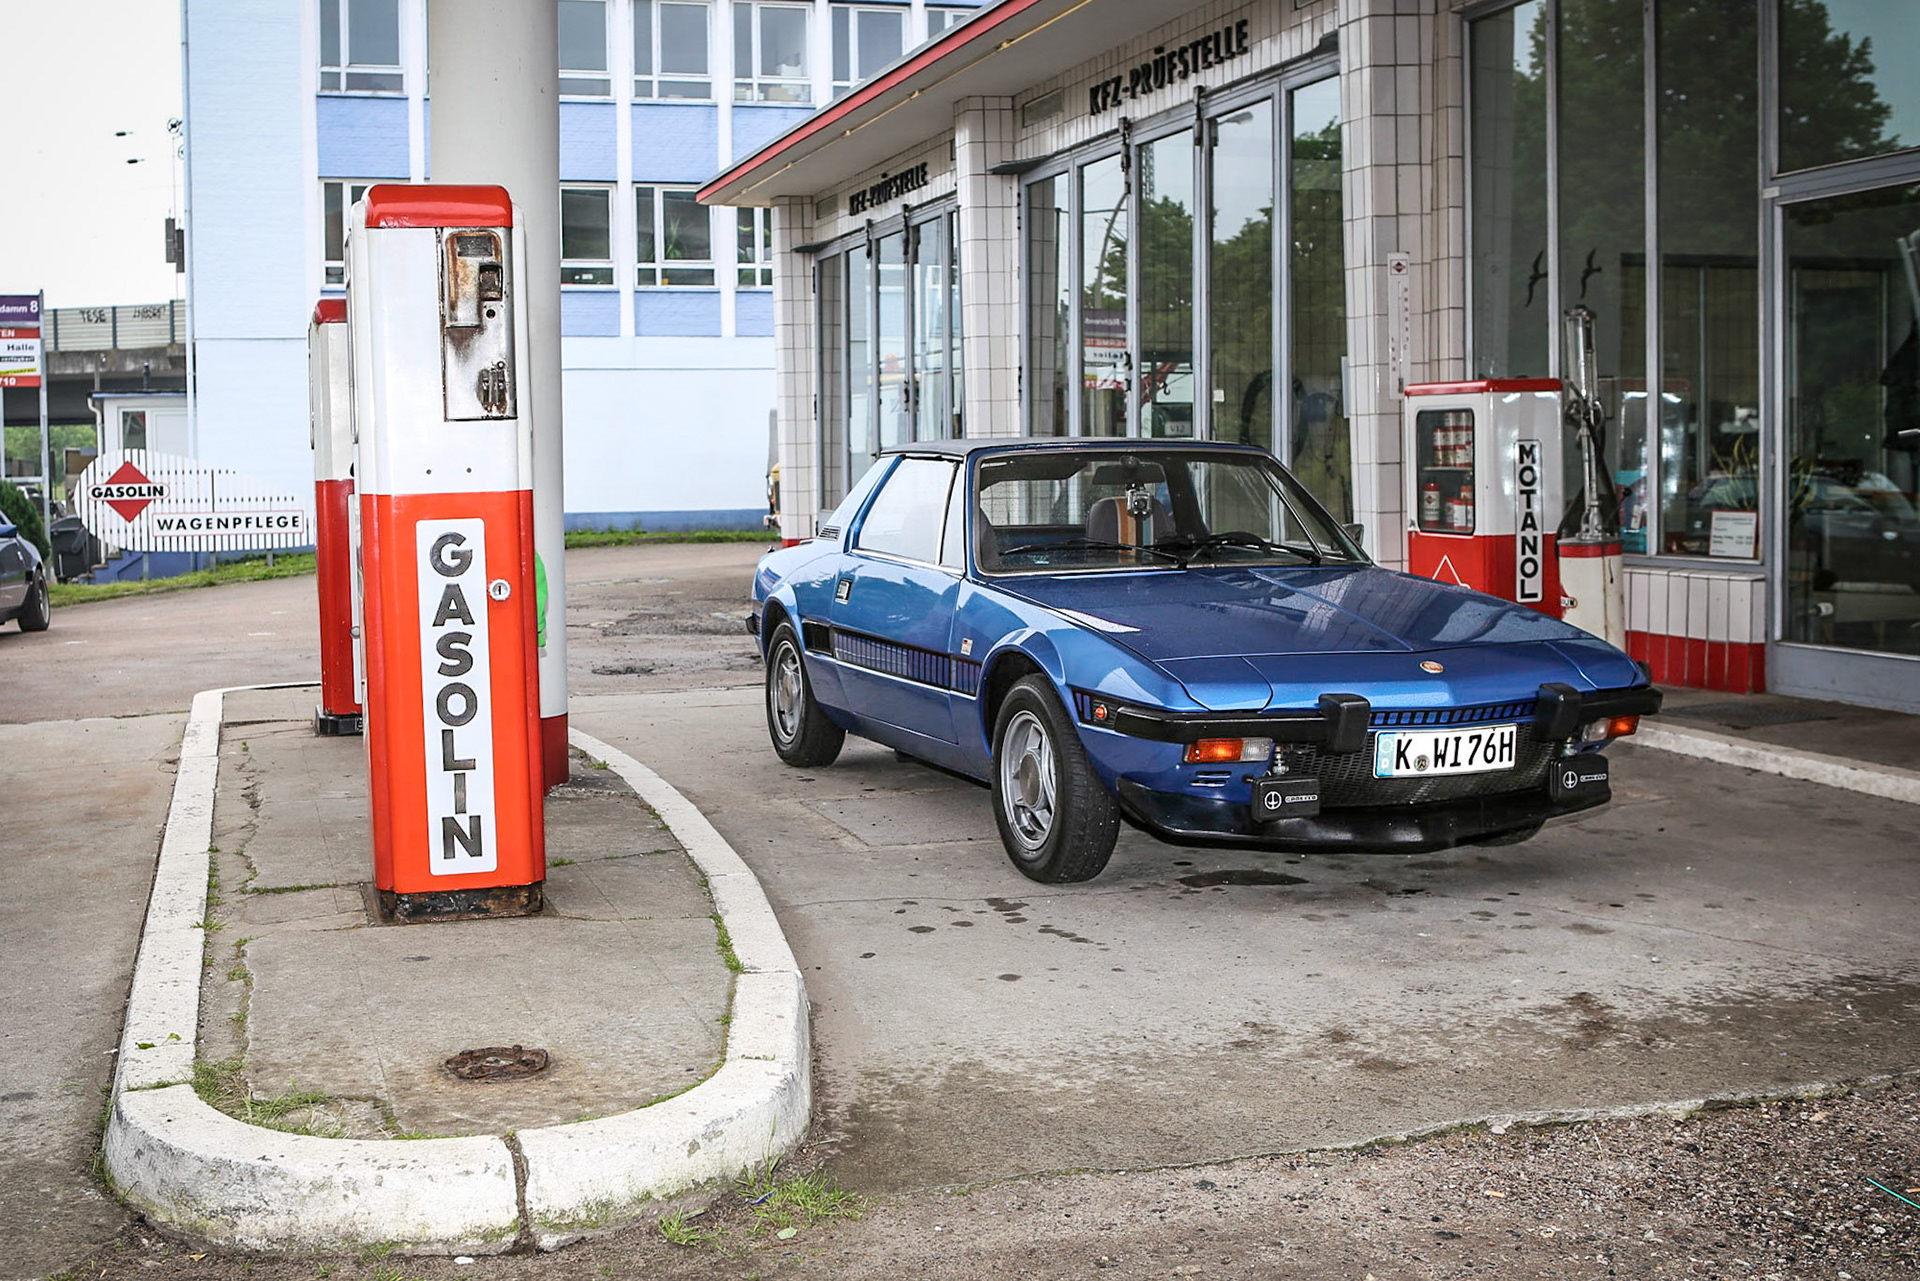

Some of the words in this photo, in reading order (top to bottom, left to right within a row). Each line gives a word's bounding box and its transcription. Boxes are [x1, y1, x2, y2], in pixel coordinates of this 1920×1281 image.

[1089, 19, 1248, 115] KFZ-PRÜFSTELLE
[30, 300, 38, 313] 8
[0, 329, 15, 337] EN
[91, 485, 164, 498] GASOLIN
[157, 516, 300, 531] WAGENPFLEGE
[1518, 444, 1539, 599] MOTANOL
[429, 531, 483, 860] GASOLIN
[1395, 739, 1412, 770] K
